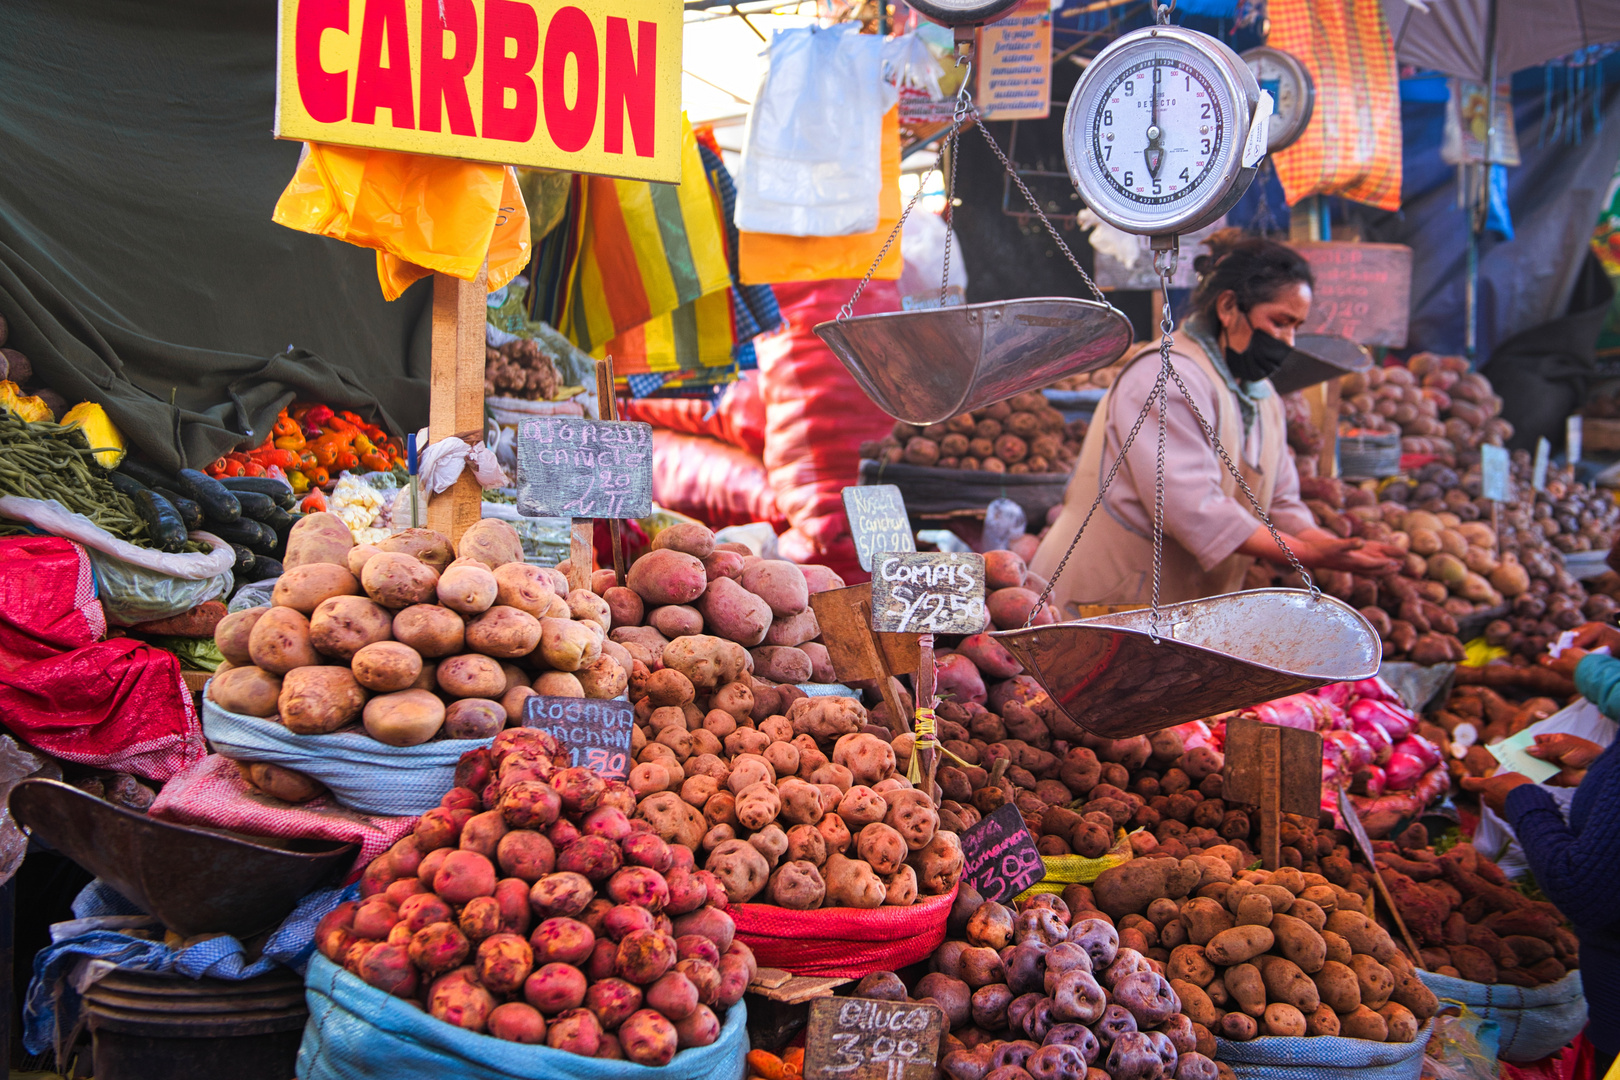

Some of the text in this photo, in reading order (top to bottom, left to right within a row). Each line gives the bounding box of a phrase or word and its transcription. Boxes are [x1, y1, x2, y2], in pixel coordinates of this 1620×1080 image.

[295, 0, 657, 158] CARBON
[1153, 68, 1161, 83] 0
[1185, 75, 1190, 92] 1
[1124, 80, 1134, 96] 9
[1104, 110, 1113, 126] 8
[1200, 103, 1211, 119] 2
[1104, 145, 1112, 161] 7
[1201, 138, 1211, 155] 3
[1124, 171, 1133, 187] 6
[1179, 167, 1189, 183] 4
[1152, 179, 1161, 195] 5
[527, 697, 634, 728] ROSADA
